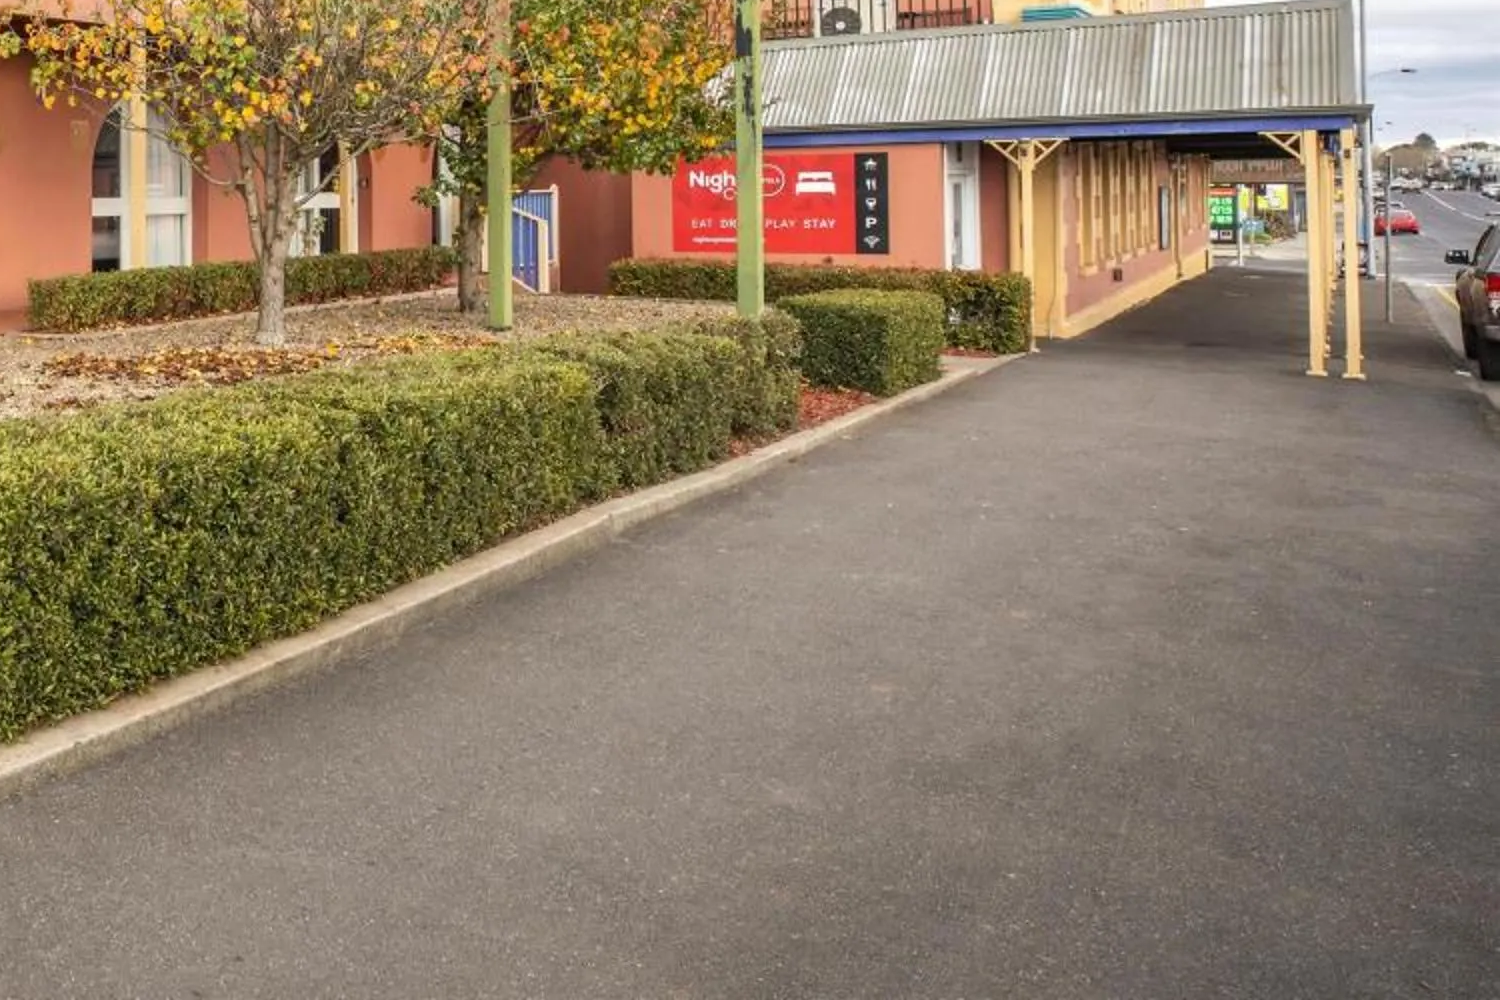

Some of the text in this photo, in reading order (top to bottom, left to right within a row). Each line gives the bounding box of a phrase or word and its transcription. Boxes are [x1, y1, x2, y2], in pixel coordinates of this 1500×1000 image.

[688, 169, 738, 193] Nigh
[691, 218, 713, 229] EAT
[765, 218, 796, 229] PLAY
[803, 218, 836, 229] STAY
